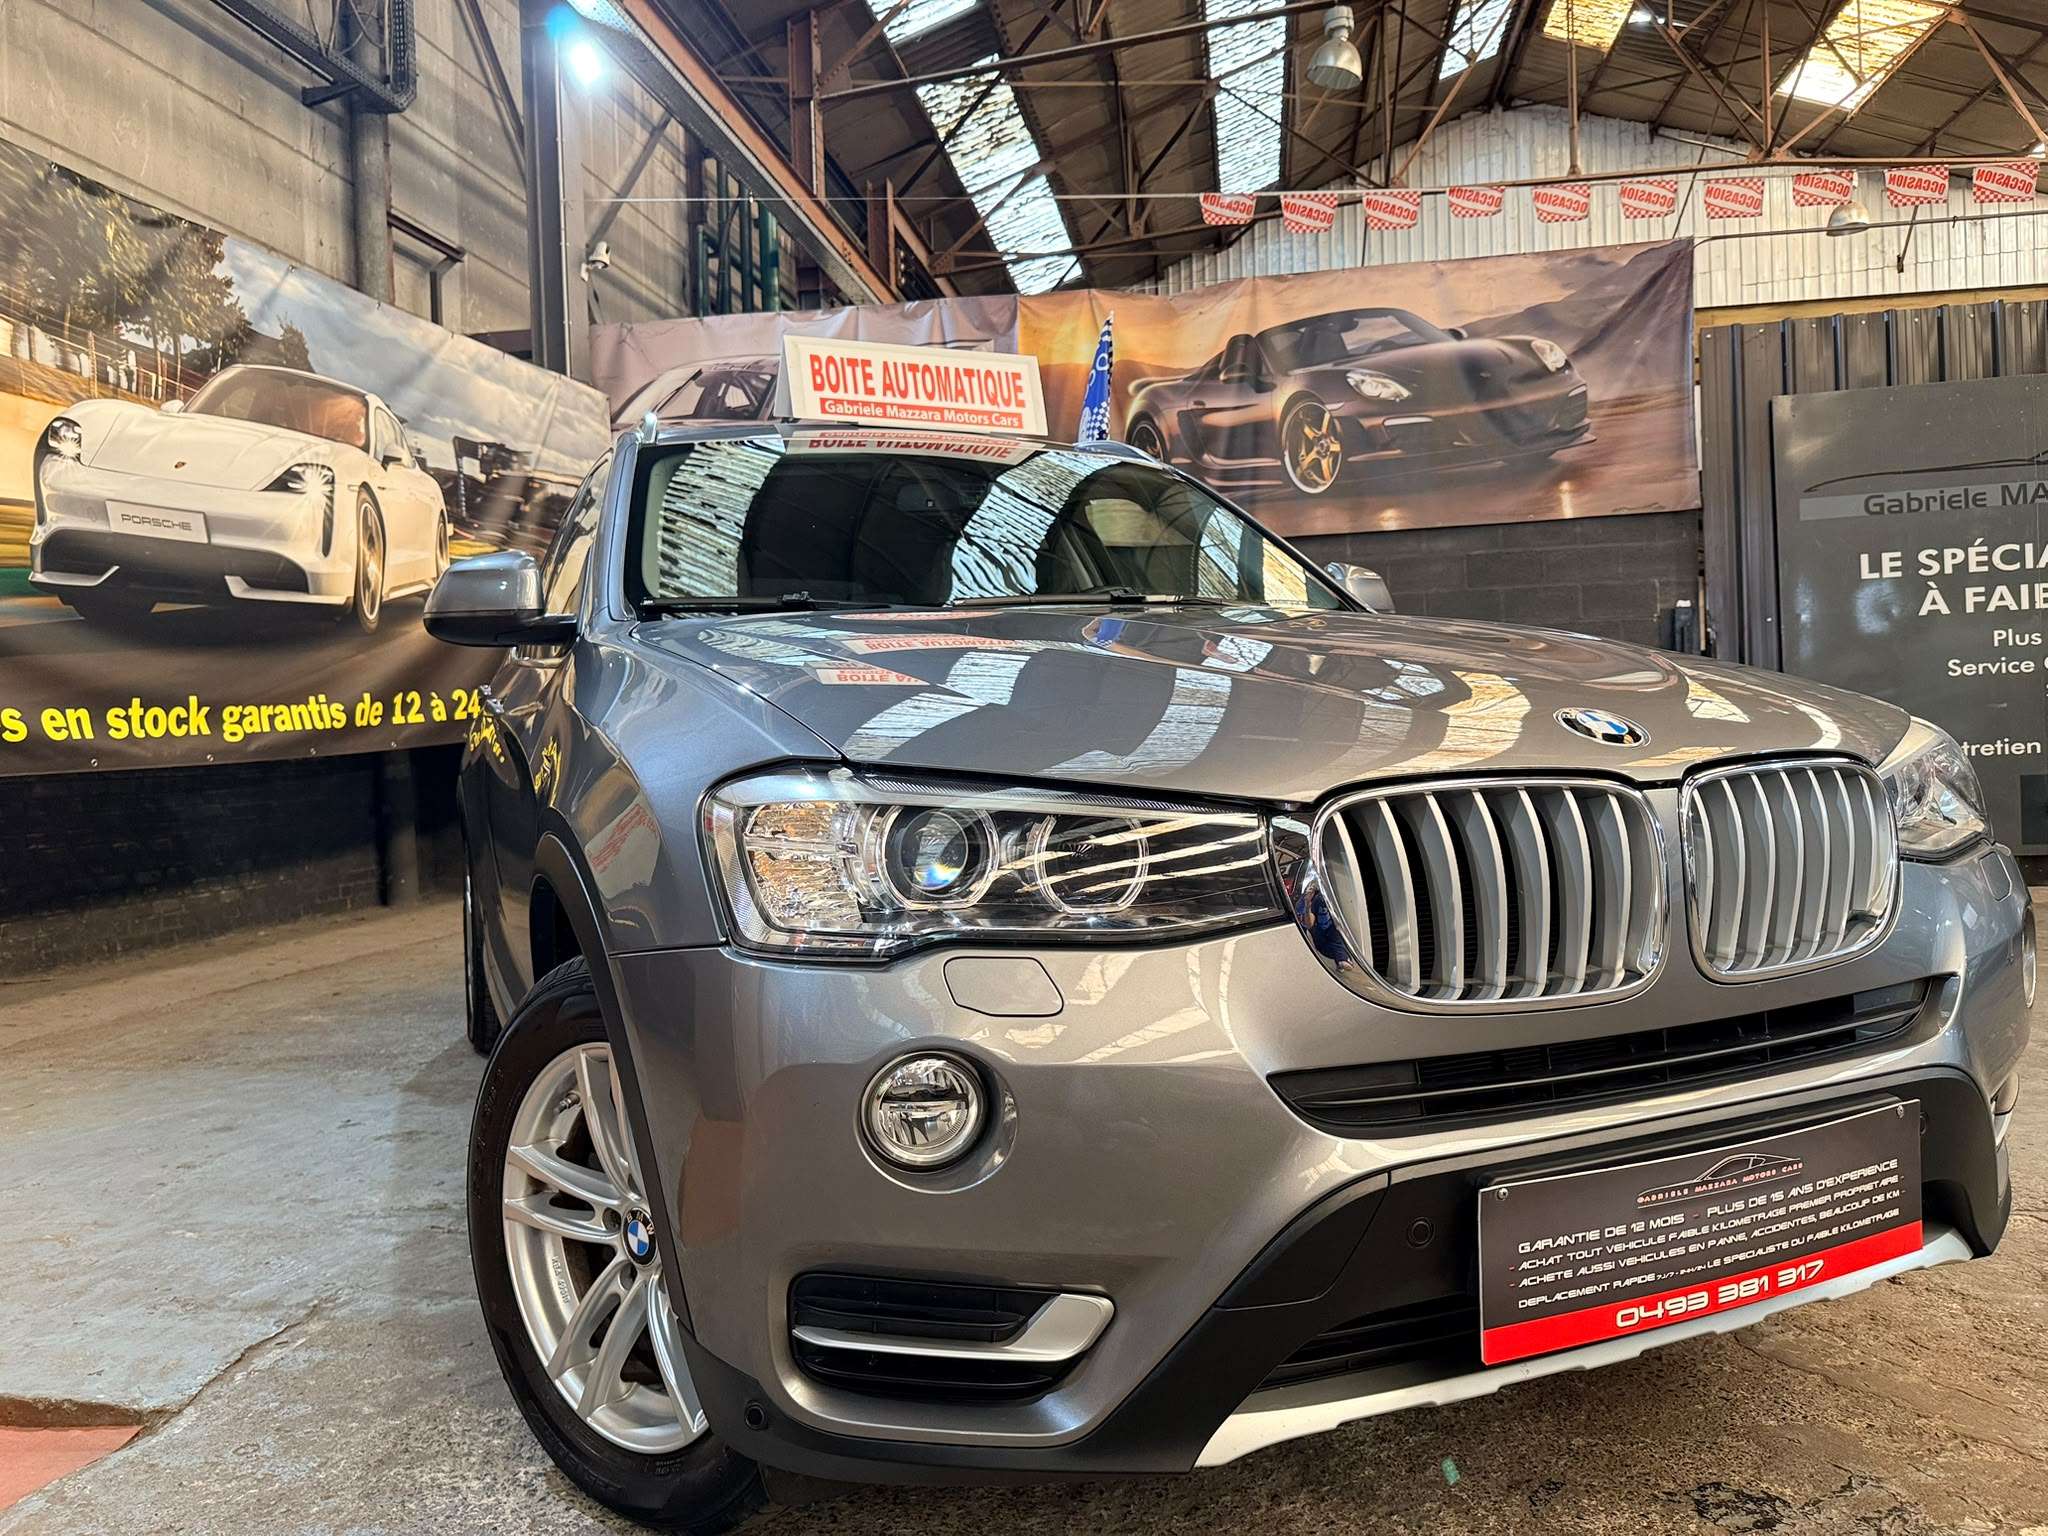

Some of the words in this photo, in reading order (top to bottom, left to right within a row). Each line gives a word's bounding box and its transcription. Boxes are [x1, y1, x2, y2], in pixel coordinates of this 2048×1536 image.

[809, 354, 876, 396] BOITE
[882, 360, 1026, 408] AUTOMATIQUE
[824, 400, 883, 417] Gabriele
[886, 404, 942, 421] Mazzara
[944, 409, 989, 425] Motors
[992, 412, 1020, 427] Cars
[1863, 487, 1987, 516] Gabriele
[120, 513, 193, 532] PORSCHE
[1859, 551, 1902, 580] LE
[1918, 582, 1950, 617] À
[1993, 628, 2042, 648] Plus
[1948, 656, 2035, 677] Service
[41, 703, 95, 741] en
[107, 696, 211, 740] stock
[222, 695, 347, 742] garantis
[354, 693, 383, 728] de
[391, 690, 426, 725] 12
[430, 692, 448, 722] à
[453, 689, 481, 719] 24
[1961, 737, 2041, 757] tretien
[1694, 1179, 1738, 1193] MAZZARA
[1742, 1168, 1777, 1183] MOTORS
[1781, 1162, 1803, 1173] CARS
[1518, 1229, 1600, 1254] GARANTIE
[1604, 1224, 1627, 1238] DE
[1631, 1221, 1645, 1233] 12
[1649, 1213, 1685, 1230] MOIS
[1707, 1200, 1745, 1218] PLUS
[1749, 1194, 1767, 1208] DE
[1770, 1190, 1785, 1203] 15
[1788, 1182, 1813, 1198] ANS
[1816, 1158, 1898, 1190] D'EXPERIENCE
[627, 1211, 655, 1235] BMW
[1518, 1254, 1563, 1271] ACHAT
[1567, 1248, 1603, 1261] TOUT
[1605, 1234, 1666, 1254] VEHICULE
[1669, 1225, 1710, 1242] FAIBLE
[1712, 1207, 1786, 1232] KILOMETRAGE
[1789, 1195, 1832, 1212] PREMIER
[1833, 1175, 1899, 1201] PROPRIETAIRE
[1518, 1269, 1574, 1288] ACHETE
[1576, 1261, 1616, 1277] AUSSI
[1618, 1246, 1686, 1268] VEHICULES
[1689, 1241, 1706, 1253] EN
[1708, 1232, 1747, 1249] PANNE,
[1750, 1214, 1817, 1239] ACCIDENTES,
[1819, 1198, 1870, 1220] BEAUCOUP
[1872, 1193, 1885, 1203] DE
[1887, 1190, 1900, 1200] KM
[1518, 1282, 1610, 1309] DEPLACEMENT
[1612, 1273, 1656, 1289] RAPIDE
[1707, 1259, 1721, 1269] LE
[1723, 1240, 1789, 1265] SPECIALISTE
[1791, 1237, 1805, 1247] DU
[1807, 1226, 1839, 1243] FAIBLE
[1840, 1208, 1900, 1233] KILOMETRAGE
[1616, 1290, 1709, 1327] 0493
[1718, 1276, 1769, 1304] 381
[1778, 1259, 1825, 1289] 317
